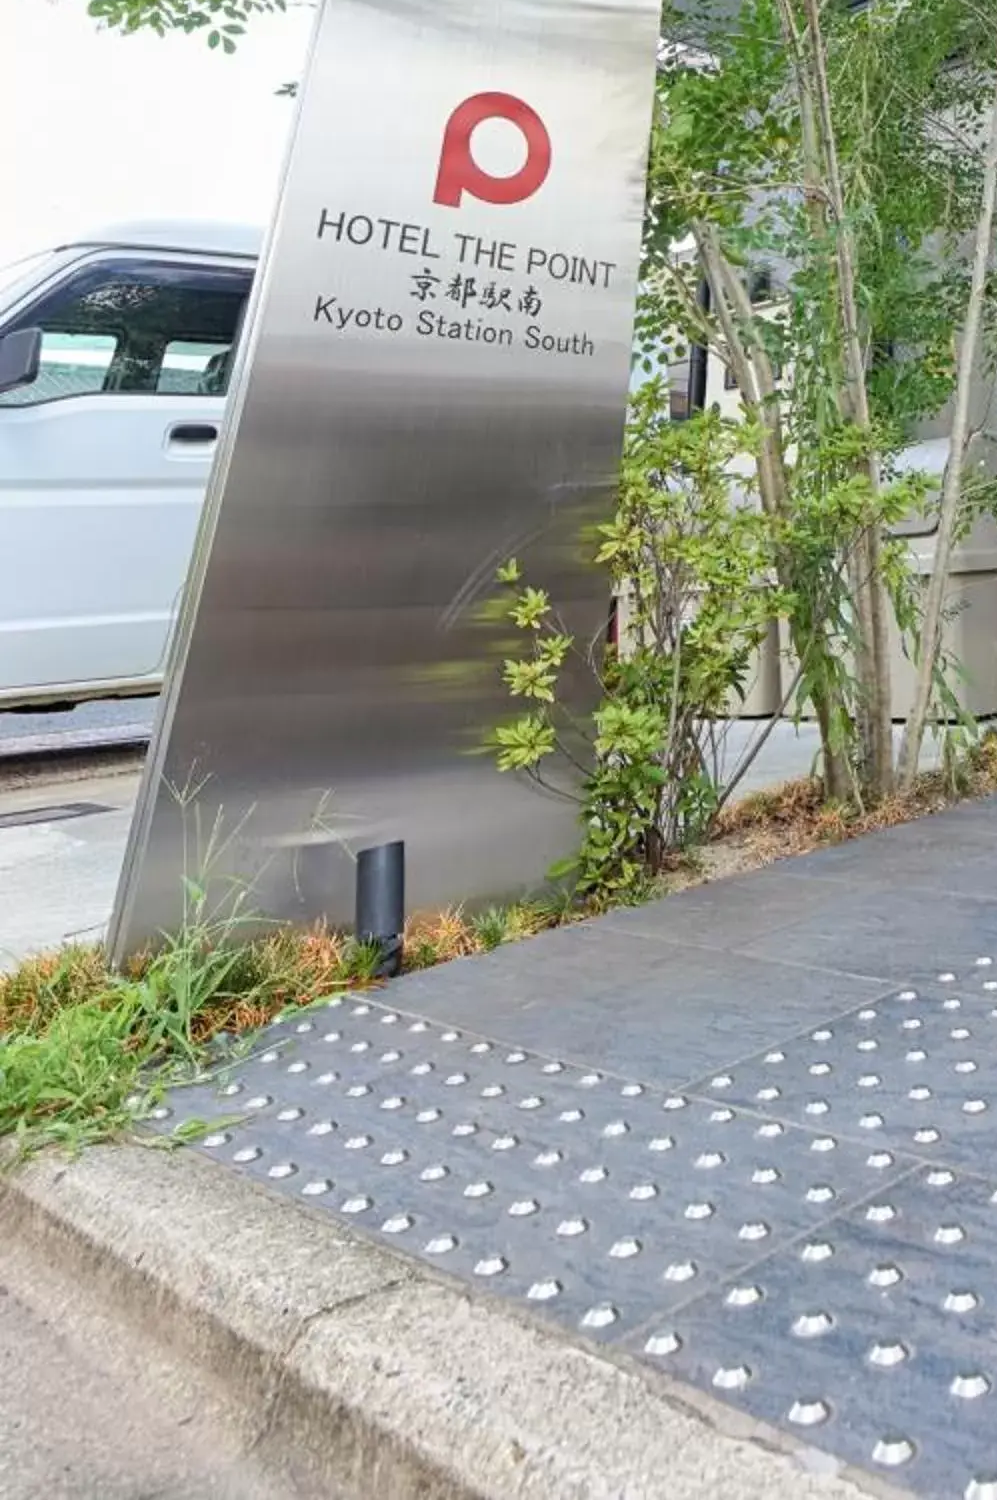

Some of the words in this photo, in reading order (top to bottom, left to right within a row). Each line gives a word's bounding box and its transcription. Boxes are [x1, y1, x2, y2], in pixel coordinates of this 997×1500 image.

[316, 208, 441, 259] HOTEL
[454, 233, 517, 272] THE
[526, 247, 617, 289] POINT
[409, 267, 542, 317] 京都駅南
[313, 296, 403, 330] Kyoto
[415, 310, 513, 346] Station
[524, 325, 594, 357] South
